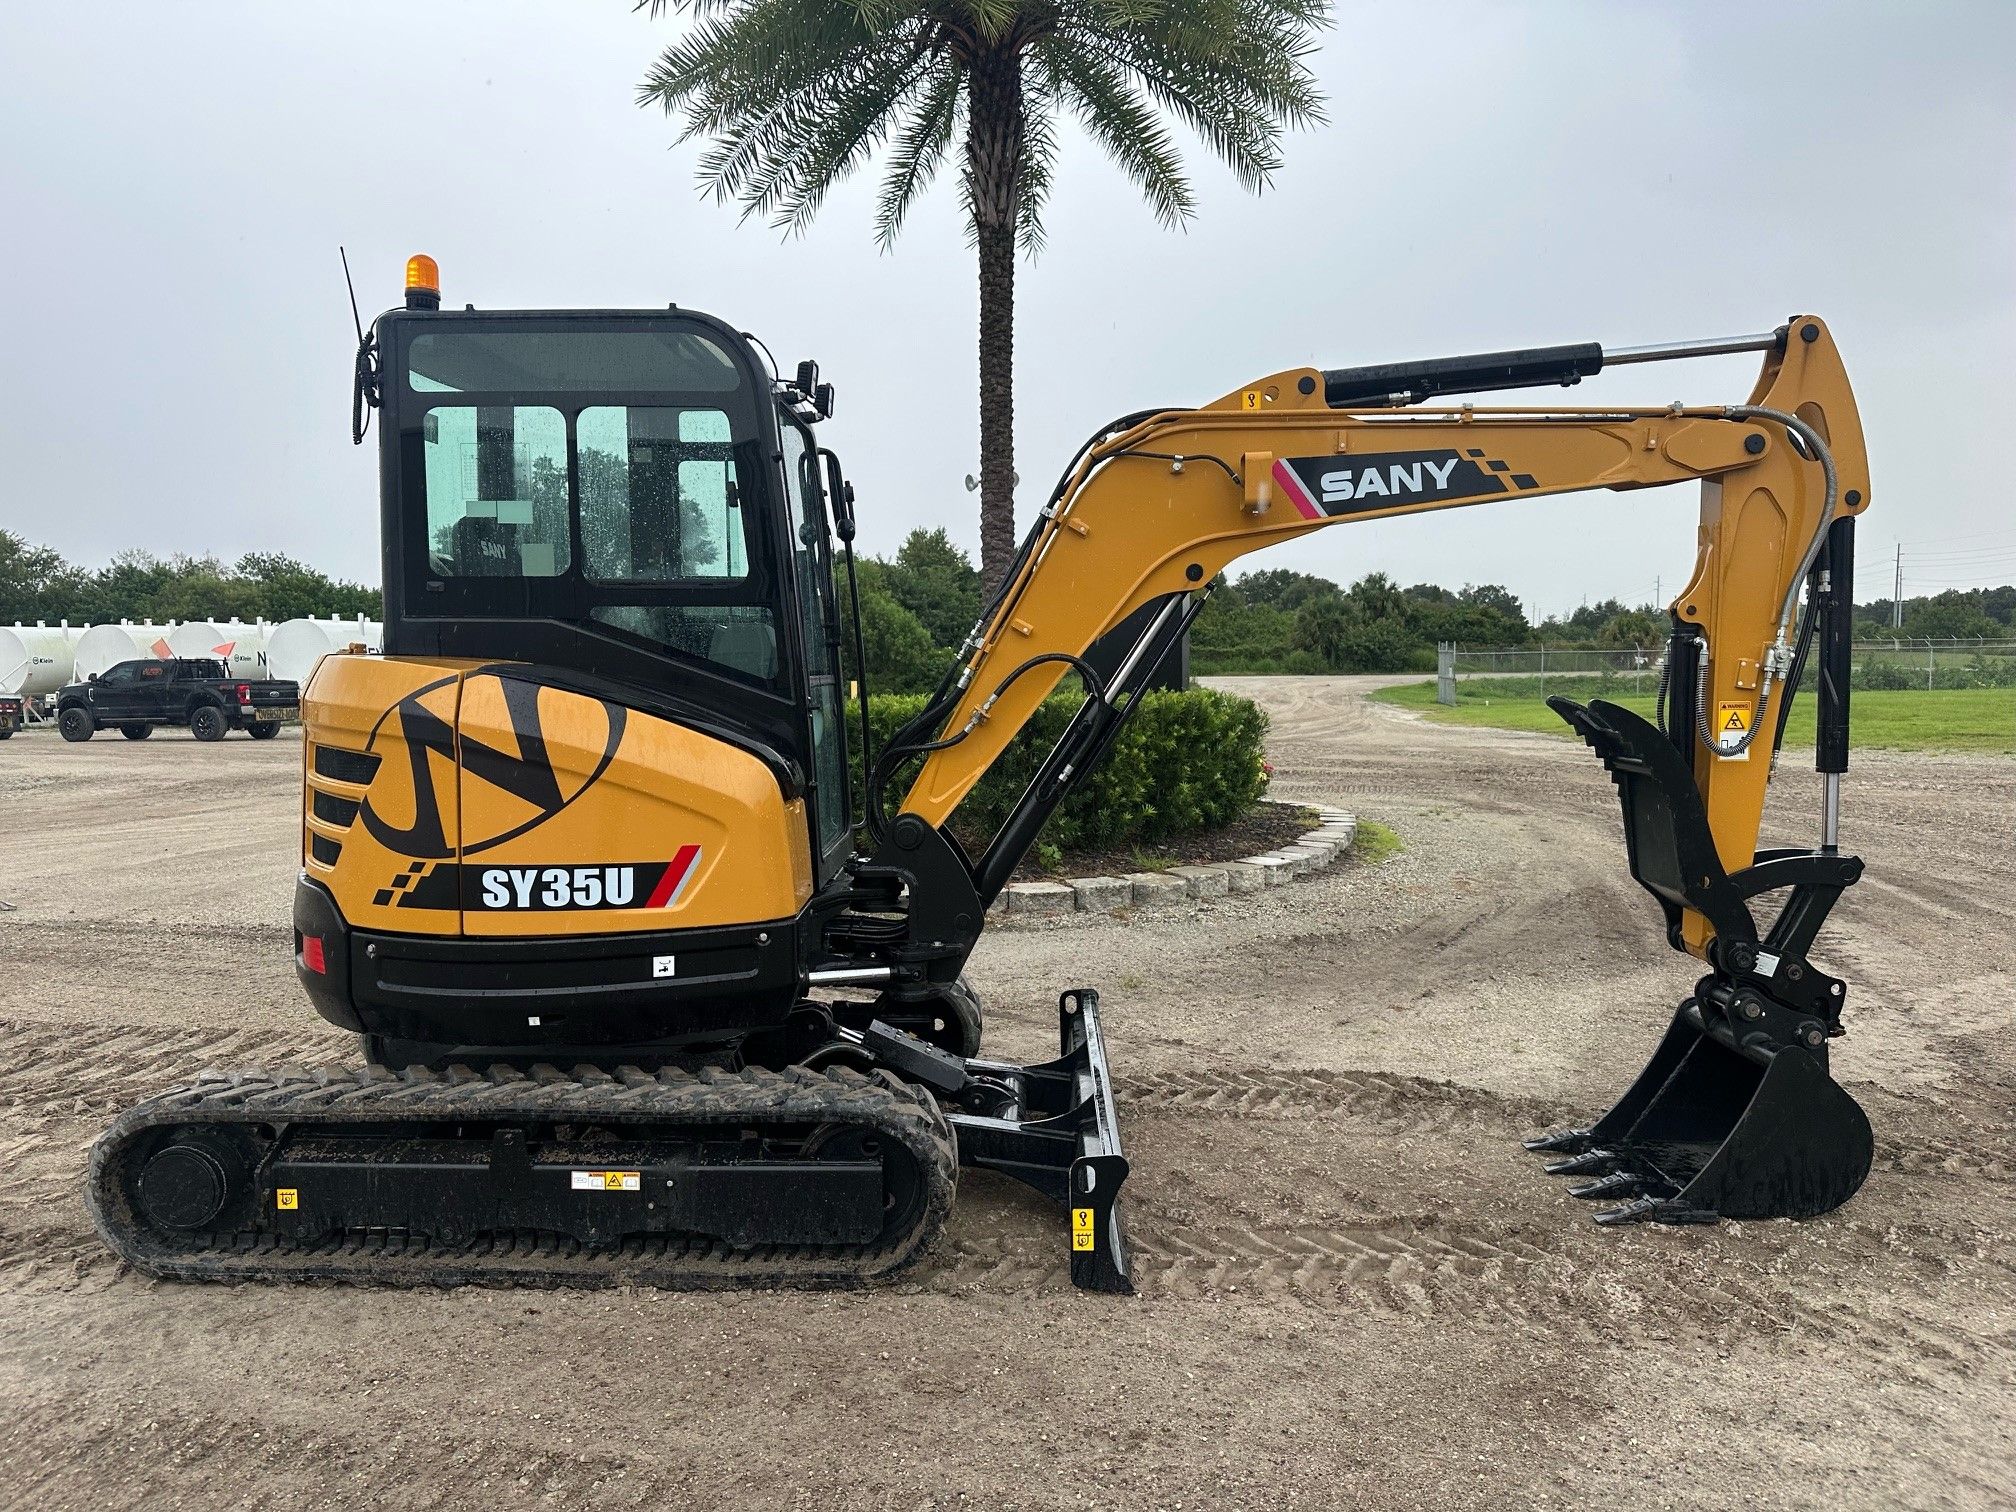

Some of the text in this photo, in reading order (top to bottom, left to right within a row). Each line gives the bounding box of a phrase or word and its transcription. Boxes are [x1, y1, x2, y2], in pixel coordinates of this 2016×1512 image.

[1320, 459, 1458, 502] SANY
[481, 540, 506, 559] SANY
[482, 867, 634, 908] SY35U
